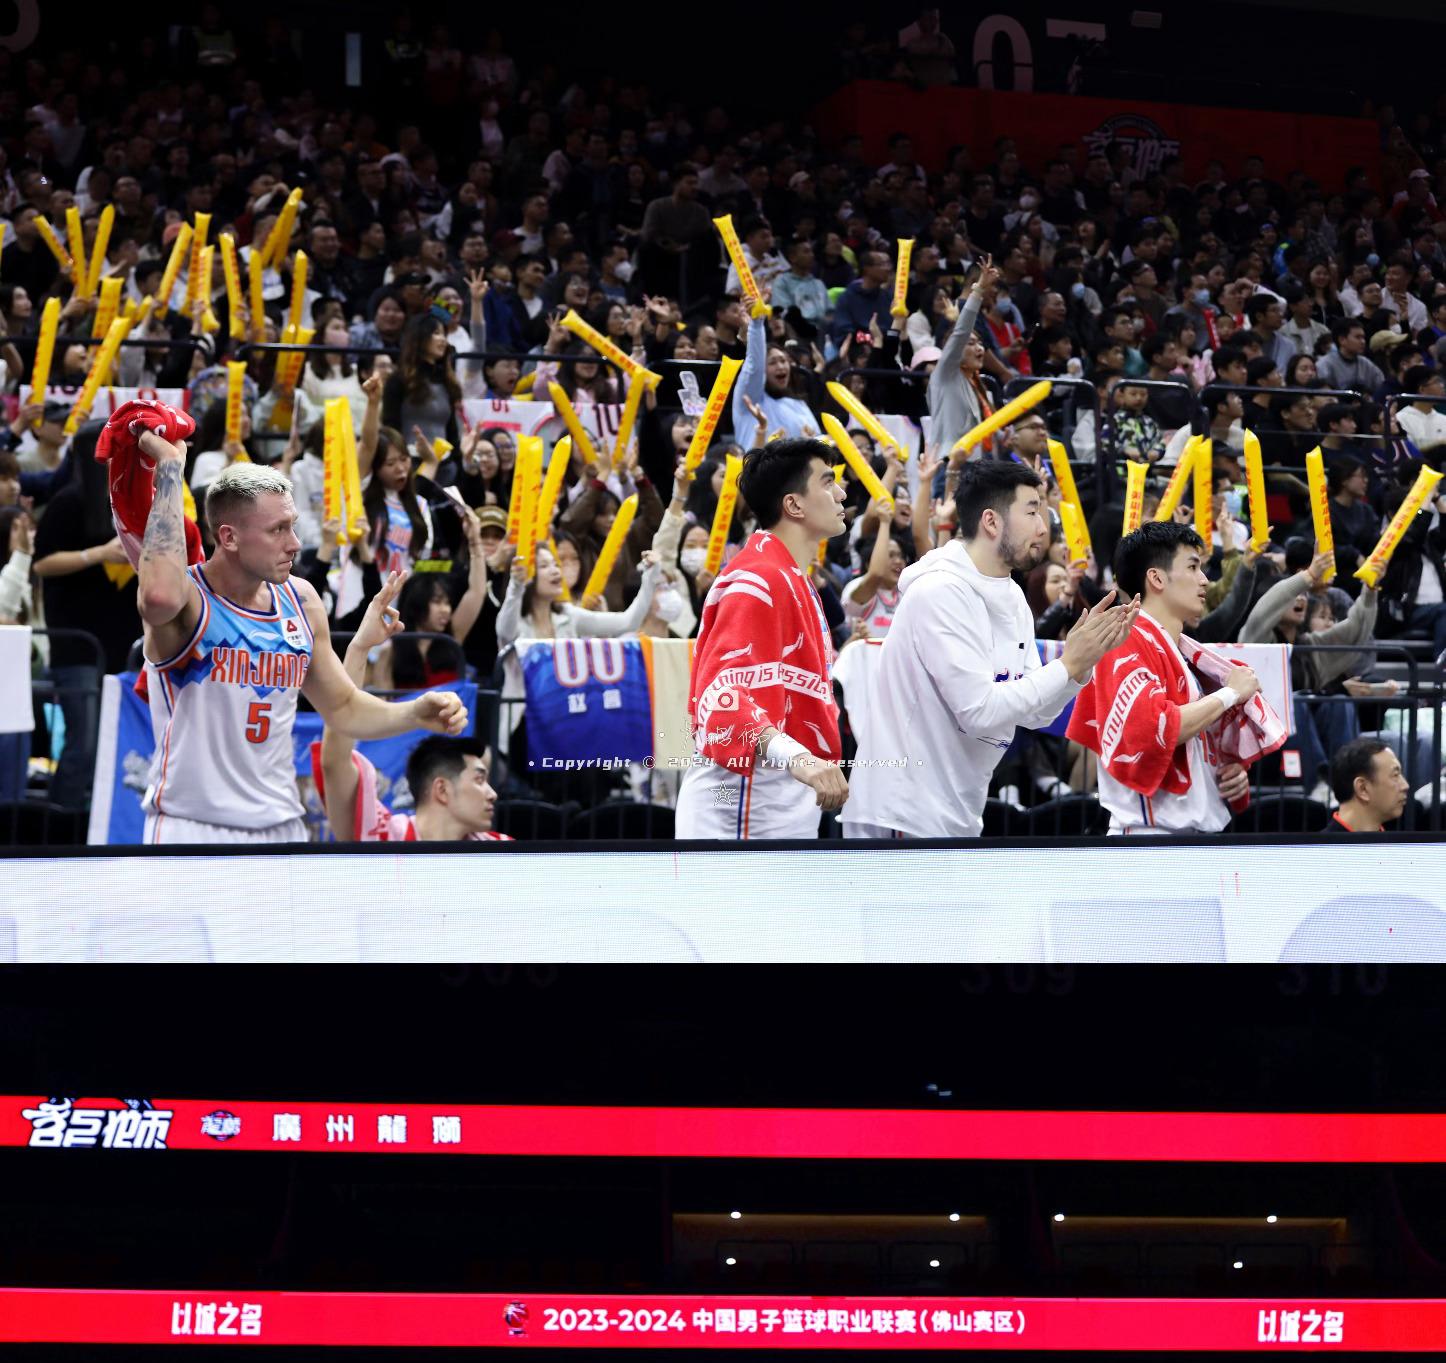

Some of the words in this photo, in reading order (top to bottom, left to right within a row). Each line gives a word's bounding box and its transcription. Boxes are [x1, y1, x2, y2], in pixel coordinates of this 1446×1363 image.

[210, 646, 309, 690] XINJIANG
[245, 702, 272, 744] 5
[171, 1302, 262, 1336] 以城之名
[543, 1308, 687, 1332] 2023-2024
[1258, 1309, 1344, 1342] 以城之名
